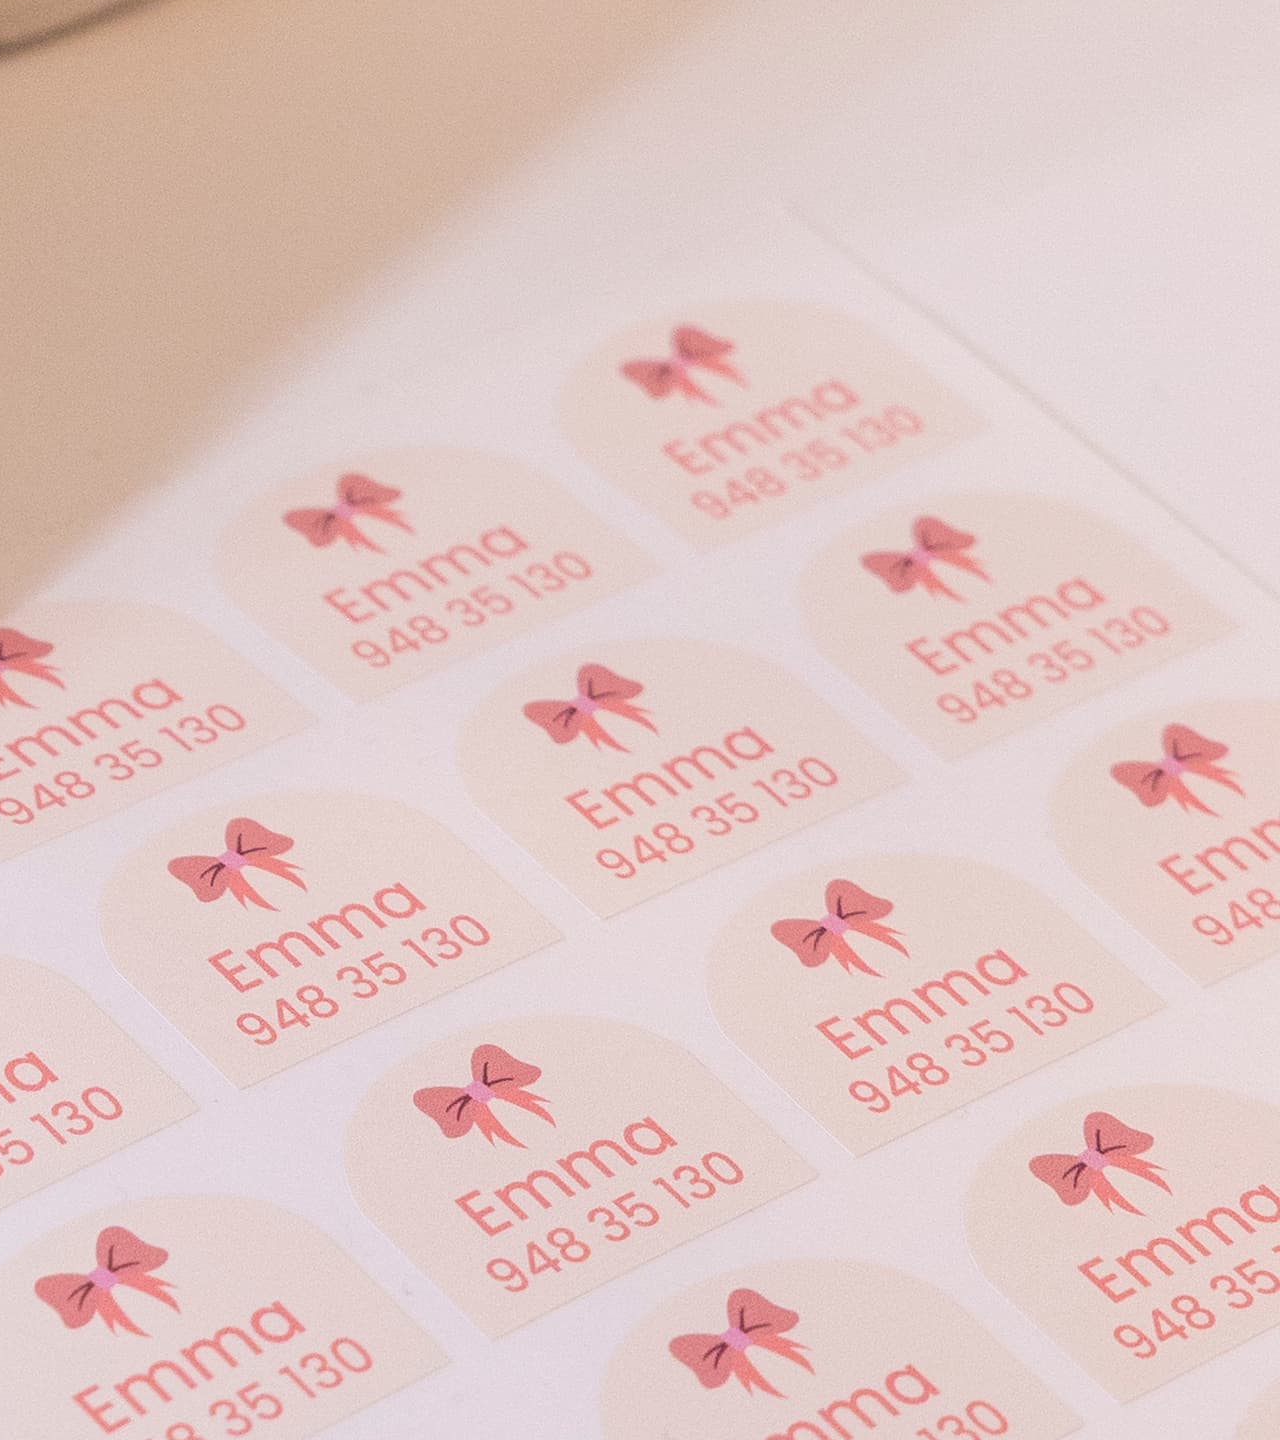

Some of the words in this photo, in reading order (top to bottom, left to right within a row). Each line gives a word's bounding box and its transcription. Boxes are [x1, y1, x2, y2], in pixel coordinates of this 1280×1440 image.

[320, 524, 532, 626] Emma
[348, 613, 451, 670] 948
[443, 583, 516, 628] 35
[504, 550, 595, 600] 130
[903, 575, 1108, 678] Emma
[934, 667, 1035, 726] 948
[1025, 637, 1097, 684] 35
[1083, 604, 1172, 657] 130
[92, 738, 165, 782] 35
[156, 702, 247, 752] 130
[563, 725, 775, 830] Emma
[594, 821, 696, 880] 948
[689, 790, 761, 837] 35
[750, 756, 840, 808] 130
[206, 881, 426, 993] Emma
[234, 983, 340, 1046] 948
[334, 950, 408, 1000] 35
[399, 913, 492, 969] 130
[814, 948, 1029, 1061] Emma
[847, 1051, 951, 1114] 948
[943, 1018, 1016, 1068] 35
[1005, 981, 1095, 1036] 130
[28, 1084, 124, 1146] 130
[454, 1115, 677, 1237] Emma
[484, 1226, 592, 1293] 948
[585, 1190, 661, 1243] 35
[651, 1150, 745, 1209] 130
[1077, 1182, 1280, 1304] Emma
[1112, 1293, 1217, 1361] 948
[1208, 1256, 1280, 1310] 35
[71, 1300, 306, 1434] Emma
[207, 1380, 285, 1438] 35
[276, 1335, 374, 1400] 130
